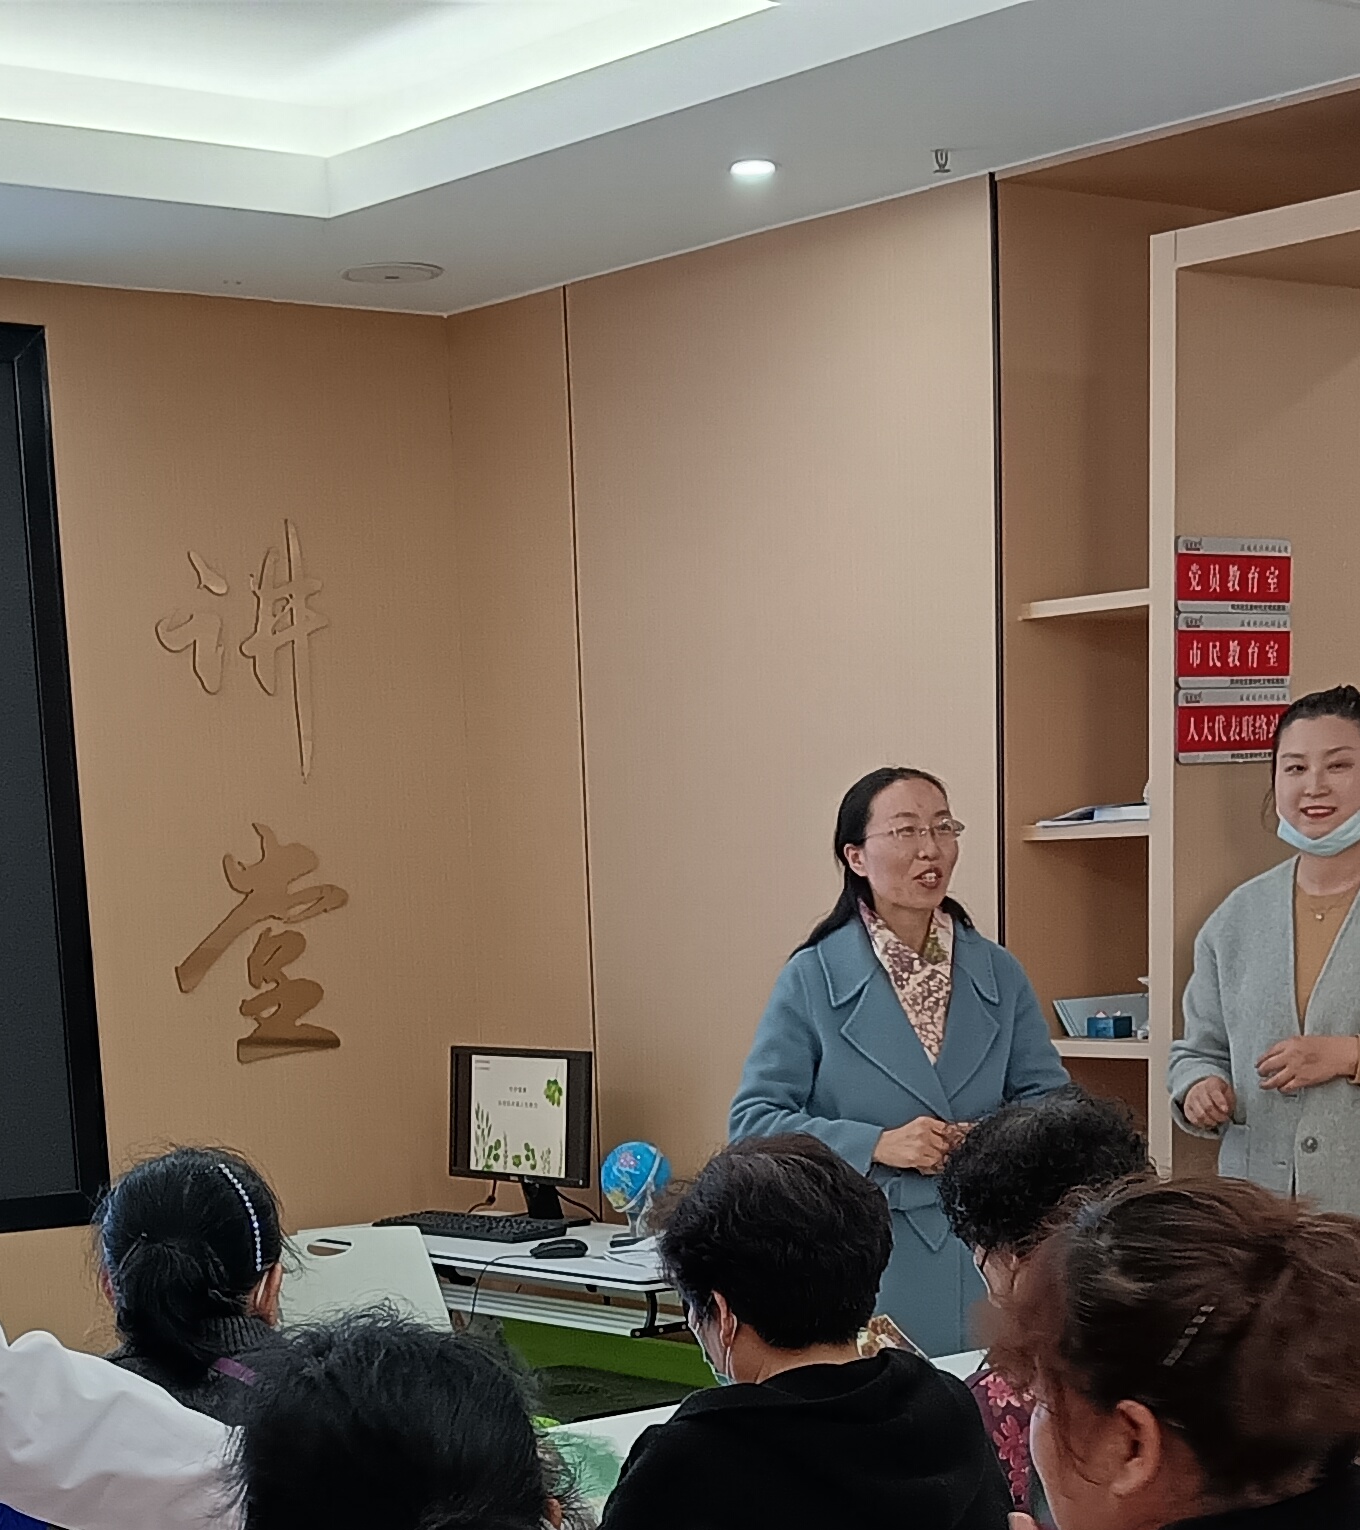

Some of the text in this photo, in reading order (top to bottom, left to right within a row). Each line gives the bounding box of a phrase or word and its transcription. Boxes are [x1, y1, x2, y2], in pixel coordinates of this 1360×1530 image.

[1188, 562, 1280, 594] 党员教育室
[1188, 639, 1280, 669] 市民教育室
